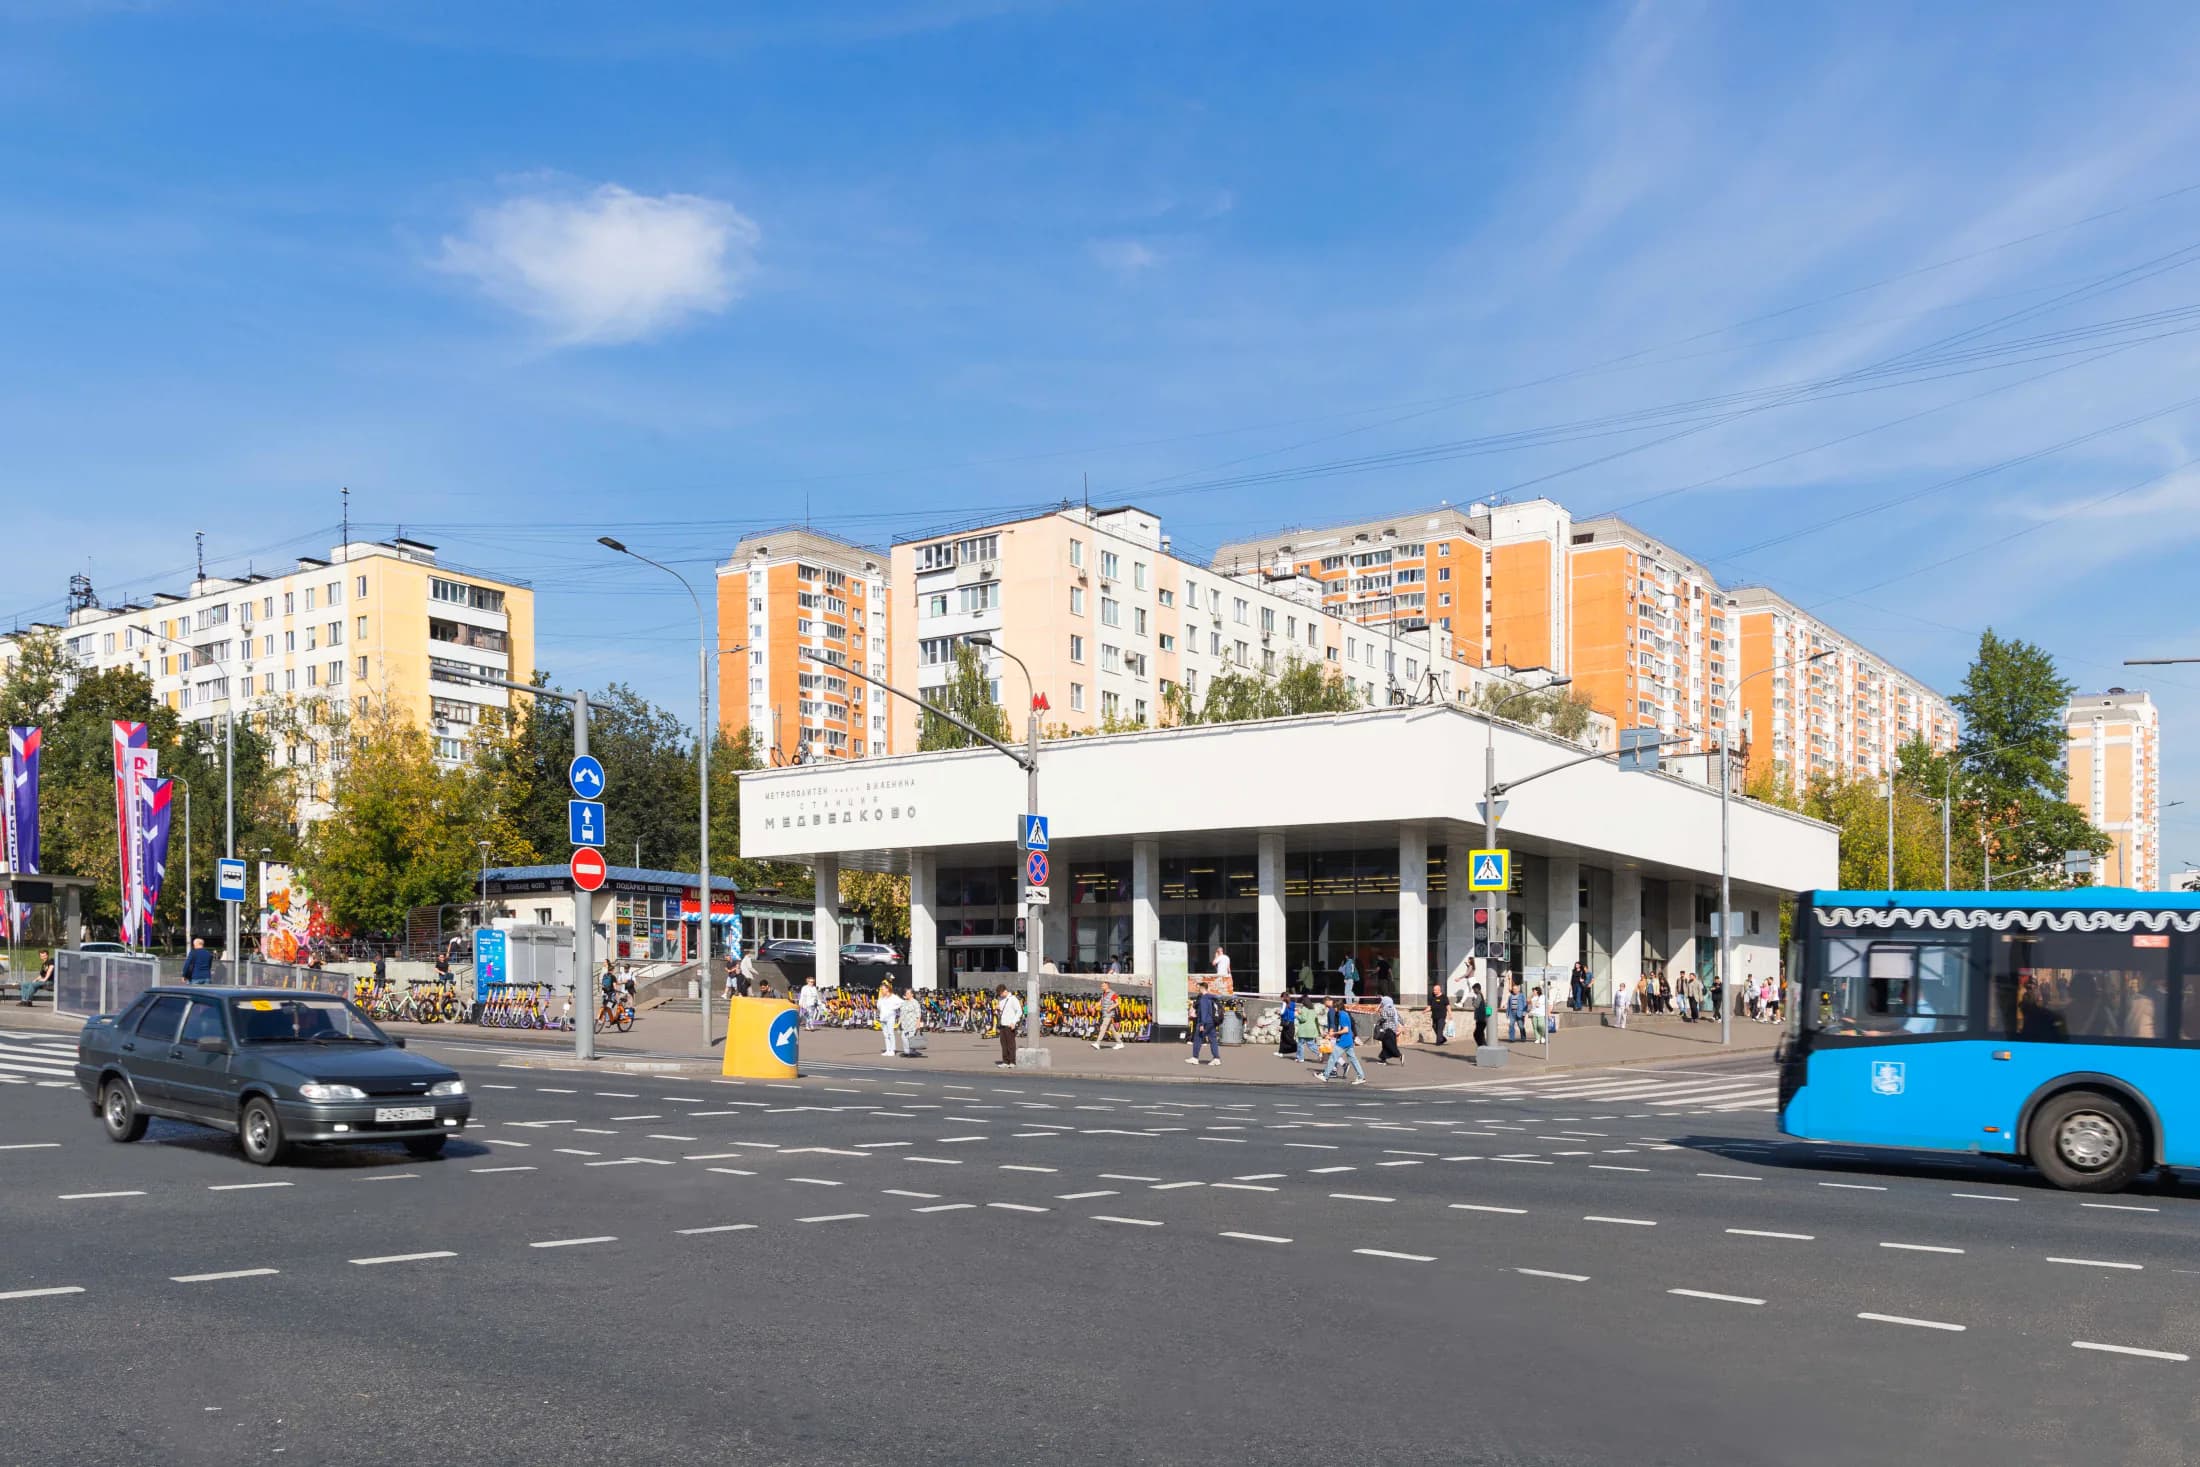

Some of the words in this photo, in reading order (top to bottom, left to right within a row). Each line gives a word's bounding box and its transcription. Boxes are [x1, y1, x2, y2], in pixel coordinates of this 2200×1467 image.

[800, 796, 879, 811] СТАНЦИЯ
[764, 805, 917, 830] МЕДВЕДКОВО
[616, 881, 646, 891] ПОДАРКИ
